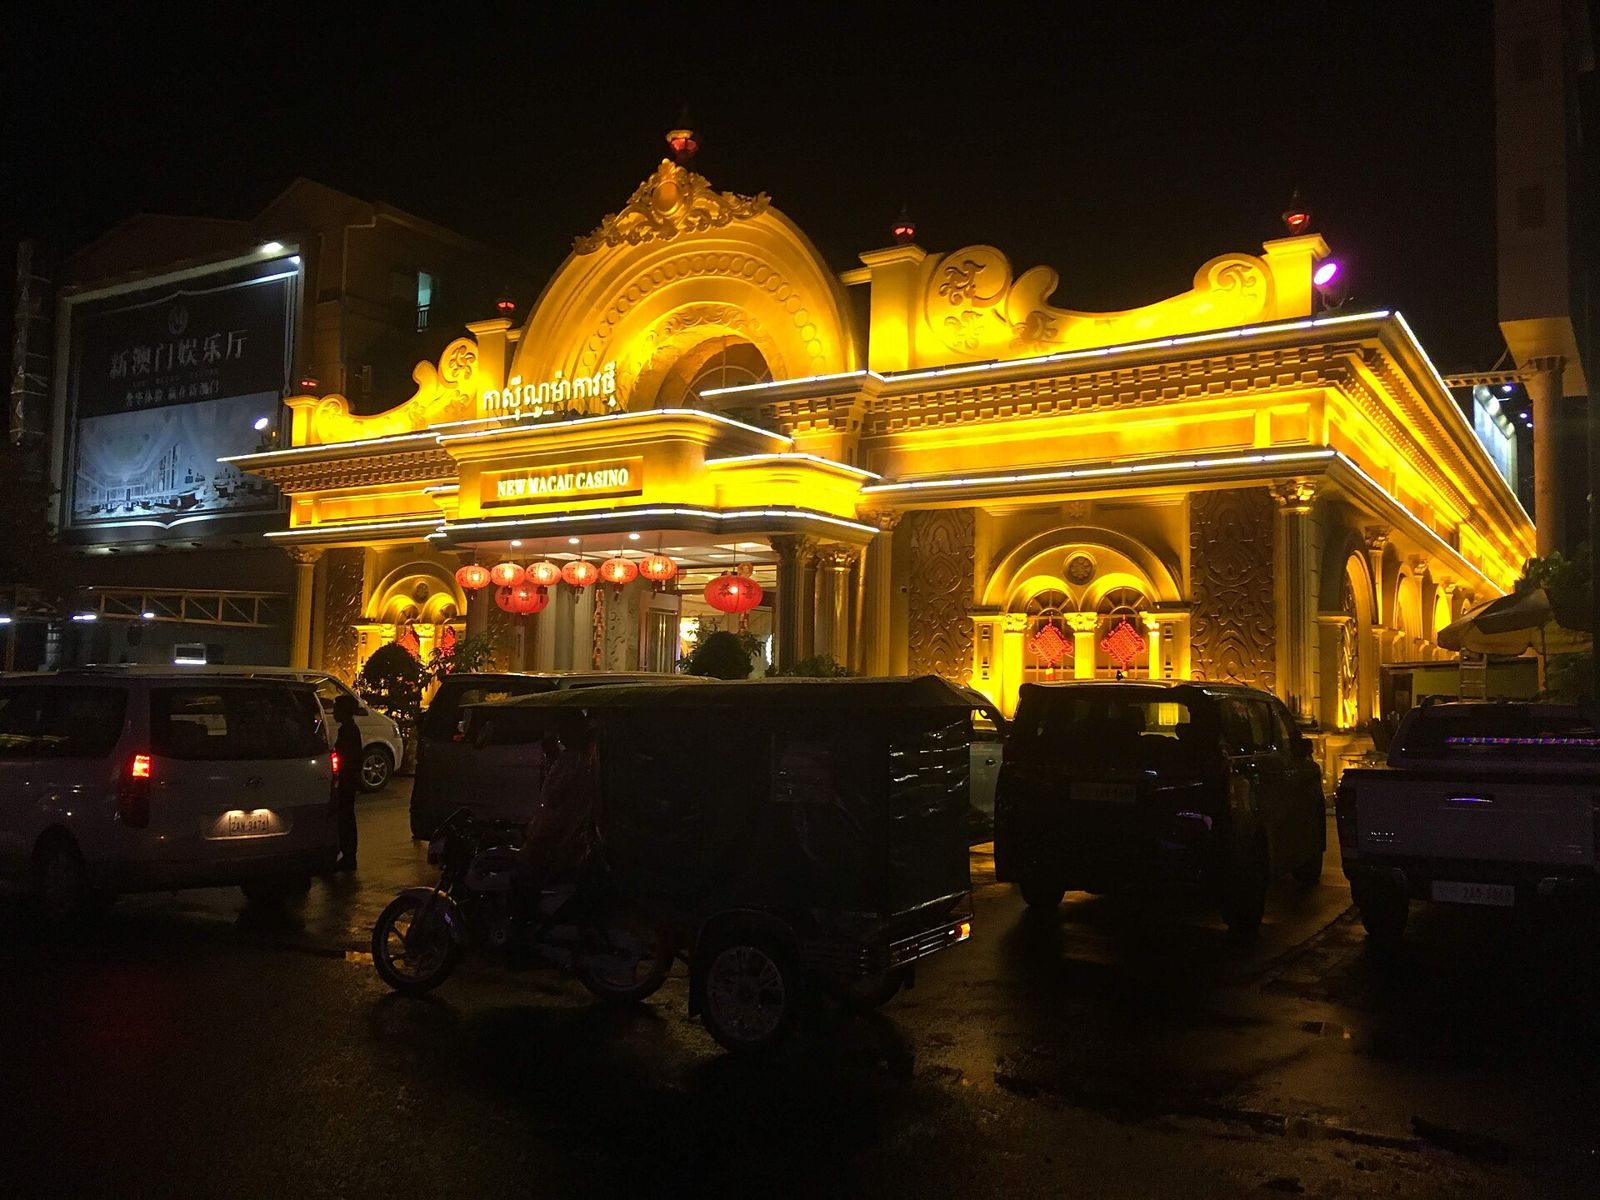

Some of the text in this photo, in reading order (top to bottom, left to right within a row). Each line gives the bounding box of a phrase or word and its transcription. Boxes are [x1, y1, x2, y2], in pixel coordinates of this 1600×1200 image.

[110, 329, 248, 379] 新澳门娱乐厅
[497, 468, 629, 497] NEW MACAU CASINO
